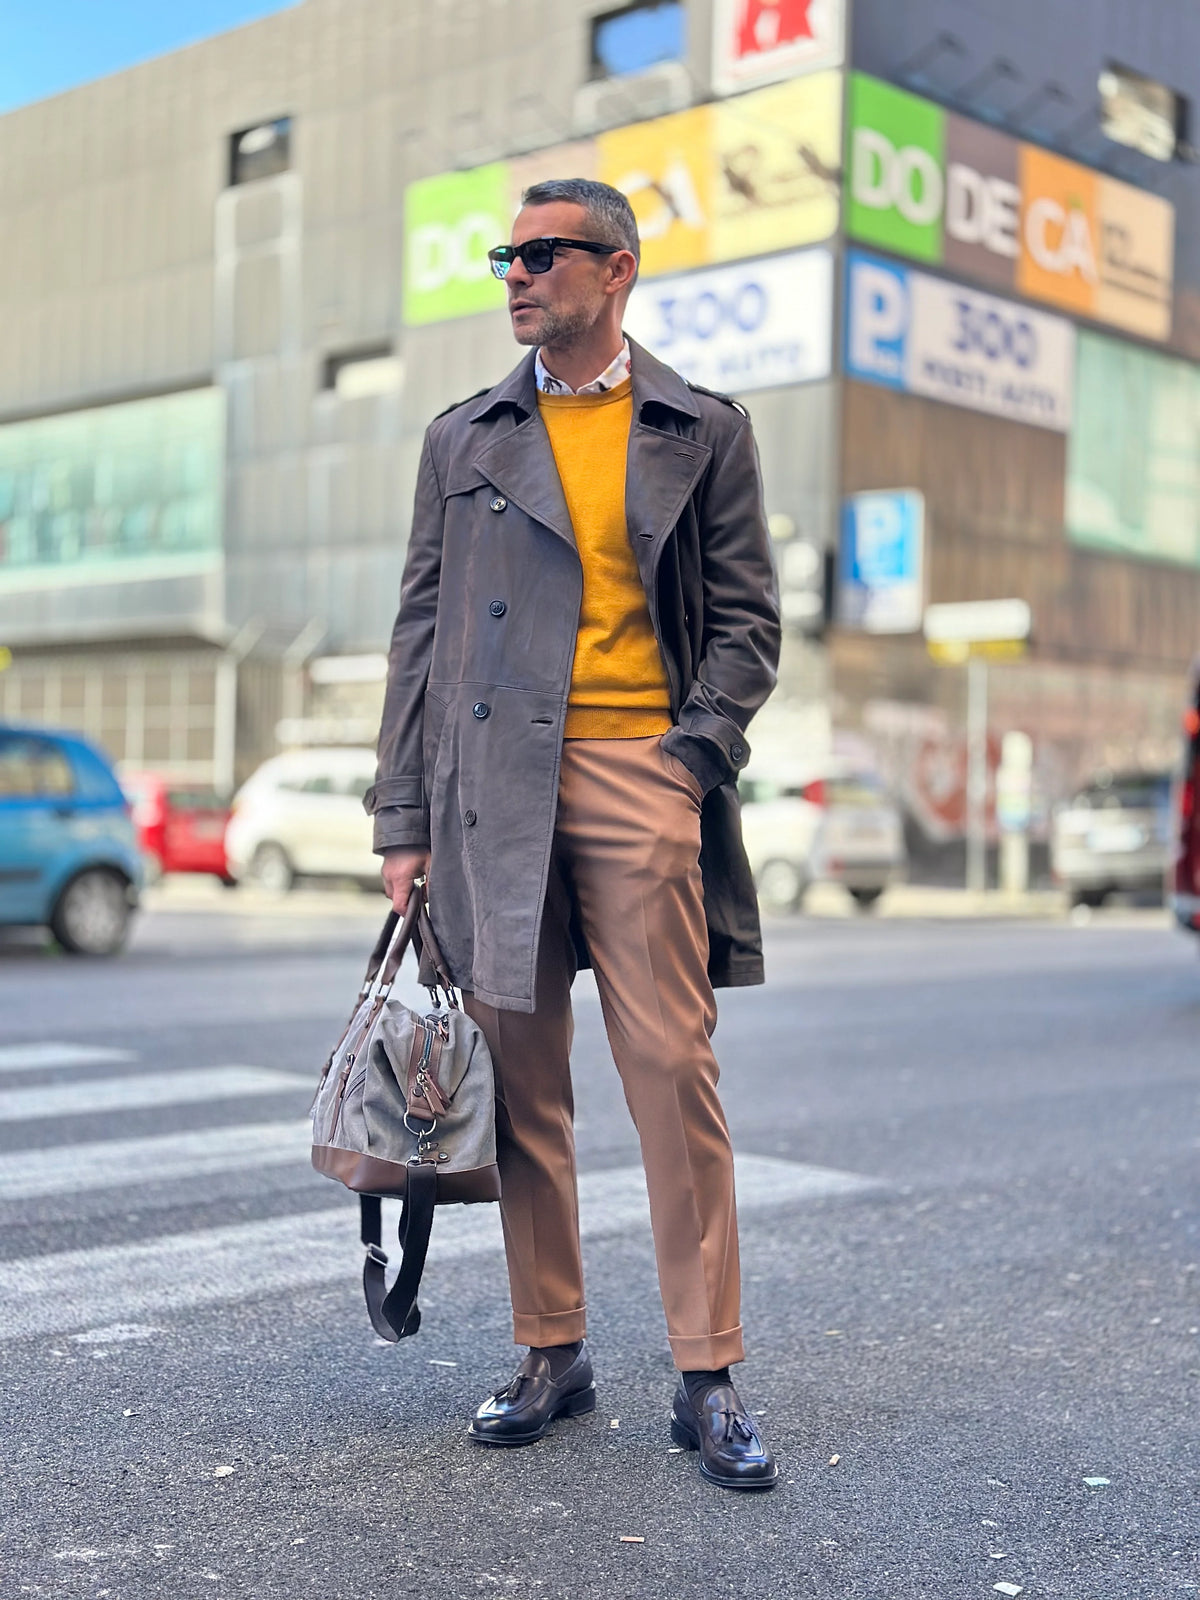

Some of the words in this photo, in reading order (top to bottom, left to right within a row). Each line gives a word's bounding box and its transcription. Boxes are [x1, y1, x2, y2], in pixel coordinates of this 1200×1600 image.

[656, 281, 768, 347] 300
[850, 263, 904, 370] P
[954, 300, 1038, 371] 300
